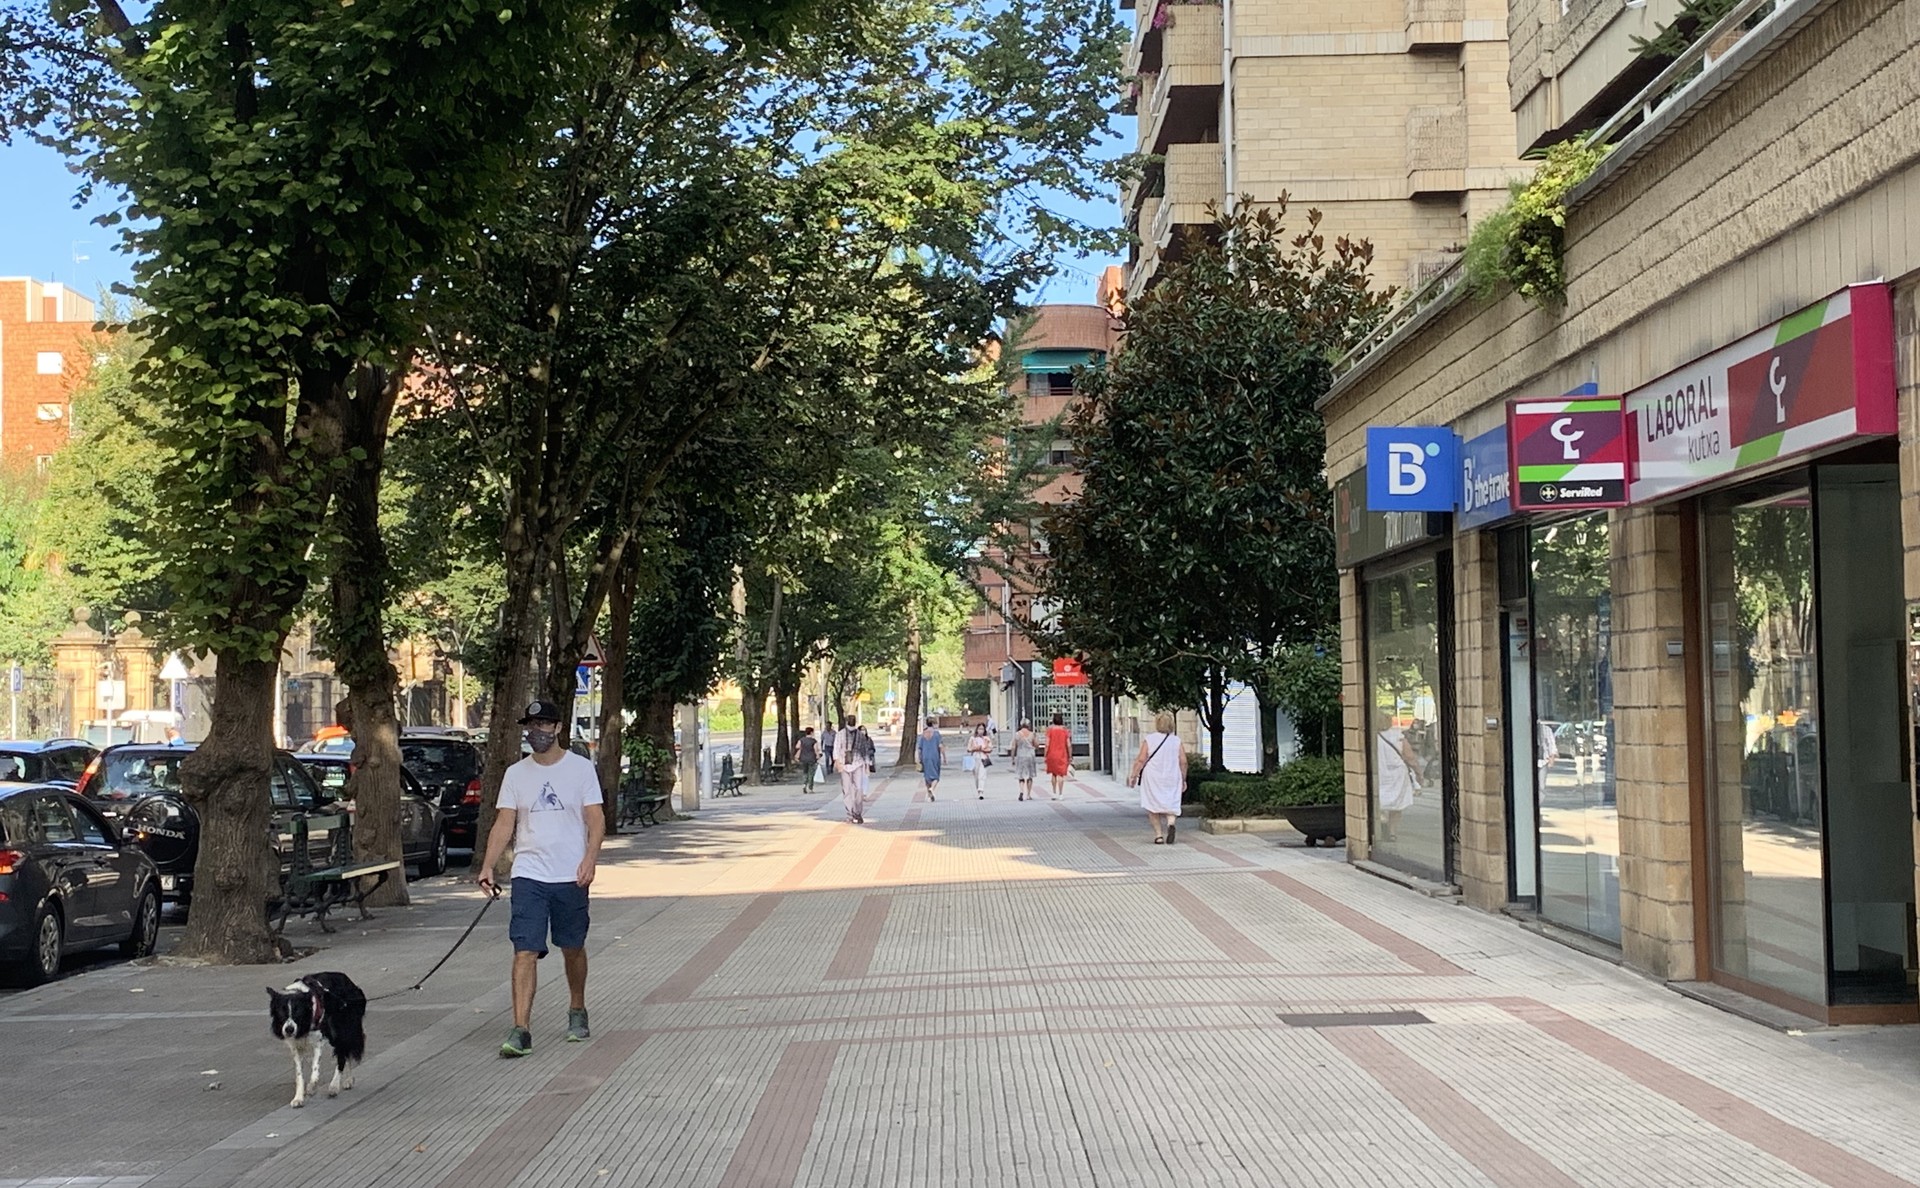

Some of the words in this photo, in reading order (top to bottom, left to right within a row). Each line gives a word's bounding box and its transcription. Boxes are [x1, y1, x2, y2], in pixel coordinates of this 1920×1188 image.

[1645, 375, 1718, 443] LABORAL
[1687, 428, 1721, 464] kutxa
[1388, 442, 1427, 495] B
[1464, 457, 1474, 513] B
[1474, 474, 1489, 508] the
[1559, 486, 1604, 499] ServiRed
[137, 823, 186, 840] HONDA
